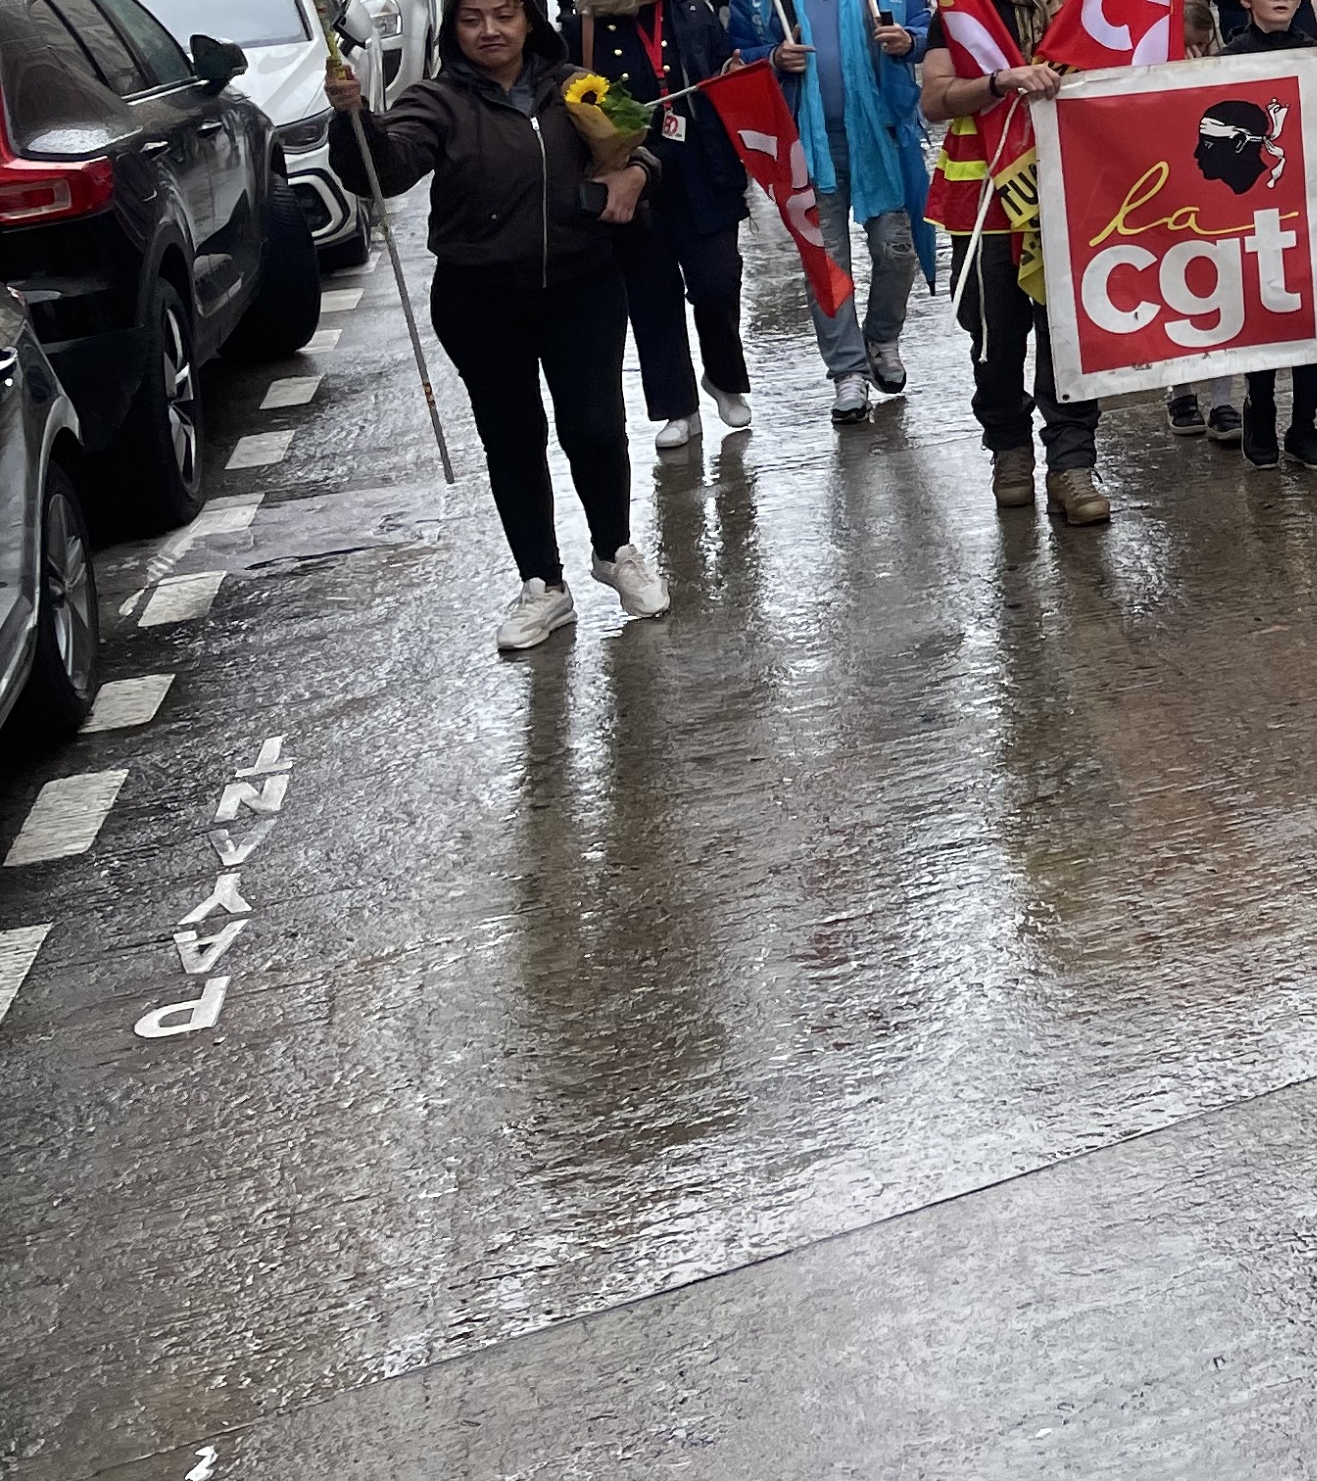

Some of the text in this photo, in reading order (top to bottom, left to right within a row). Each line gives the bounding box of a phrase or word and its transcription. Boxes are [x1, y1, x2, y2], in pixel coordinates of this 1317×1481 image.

[1089, 160, 1260, 248] la
[1081, 207, 1302, 348] cgt
[133, 733, 294, 1039] PAYANT
